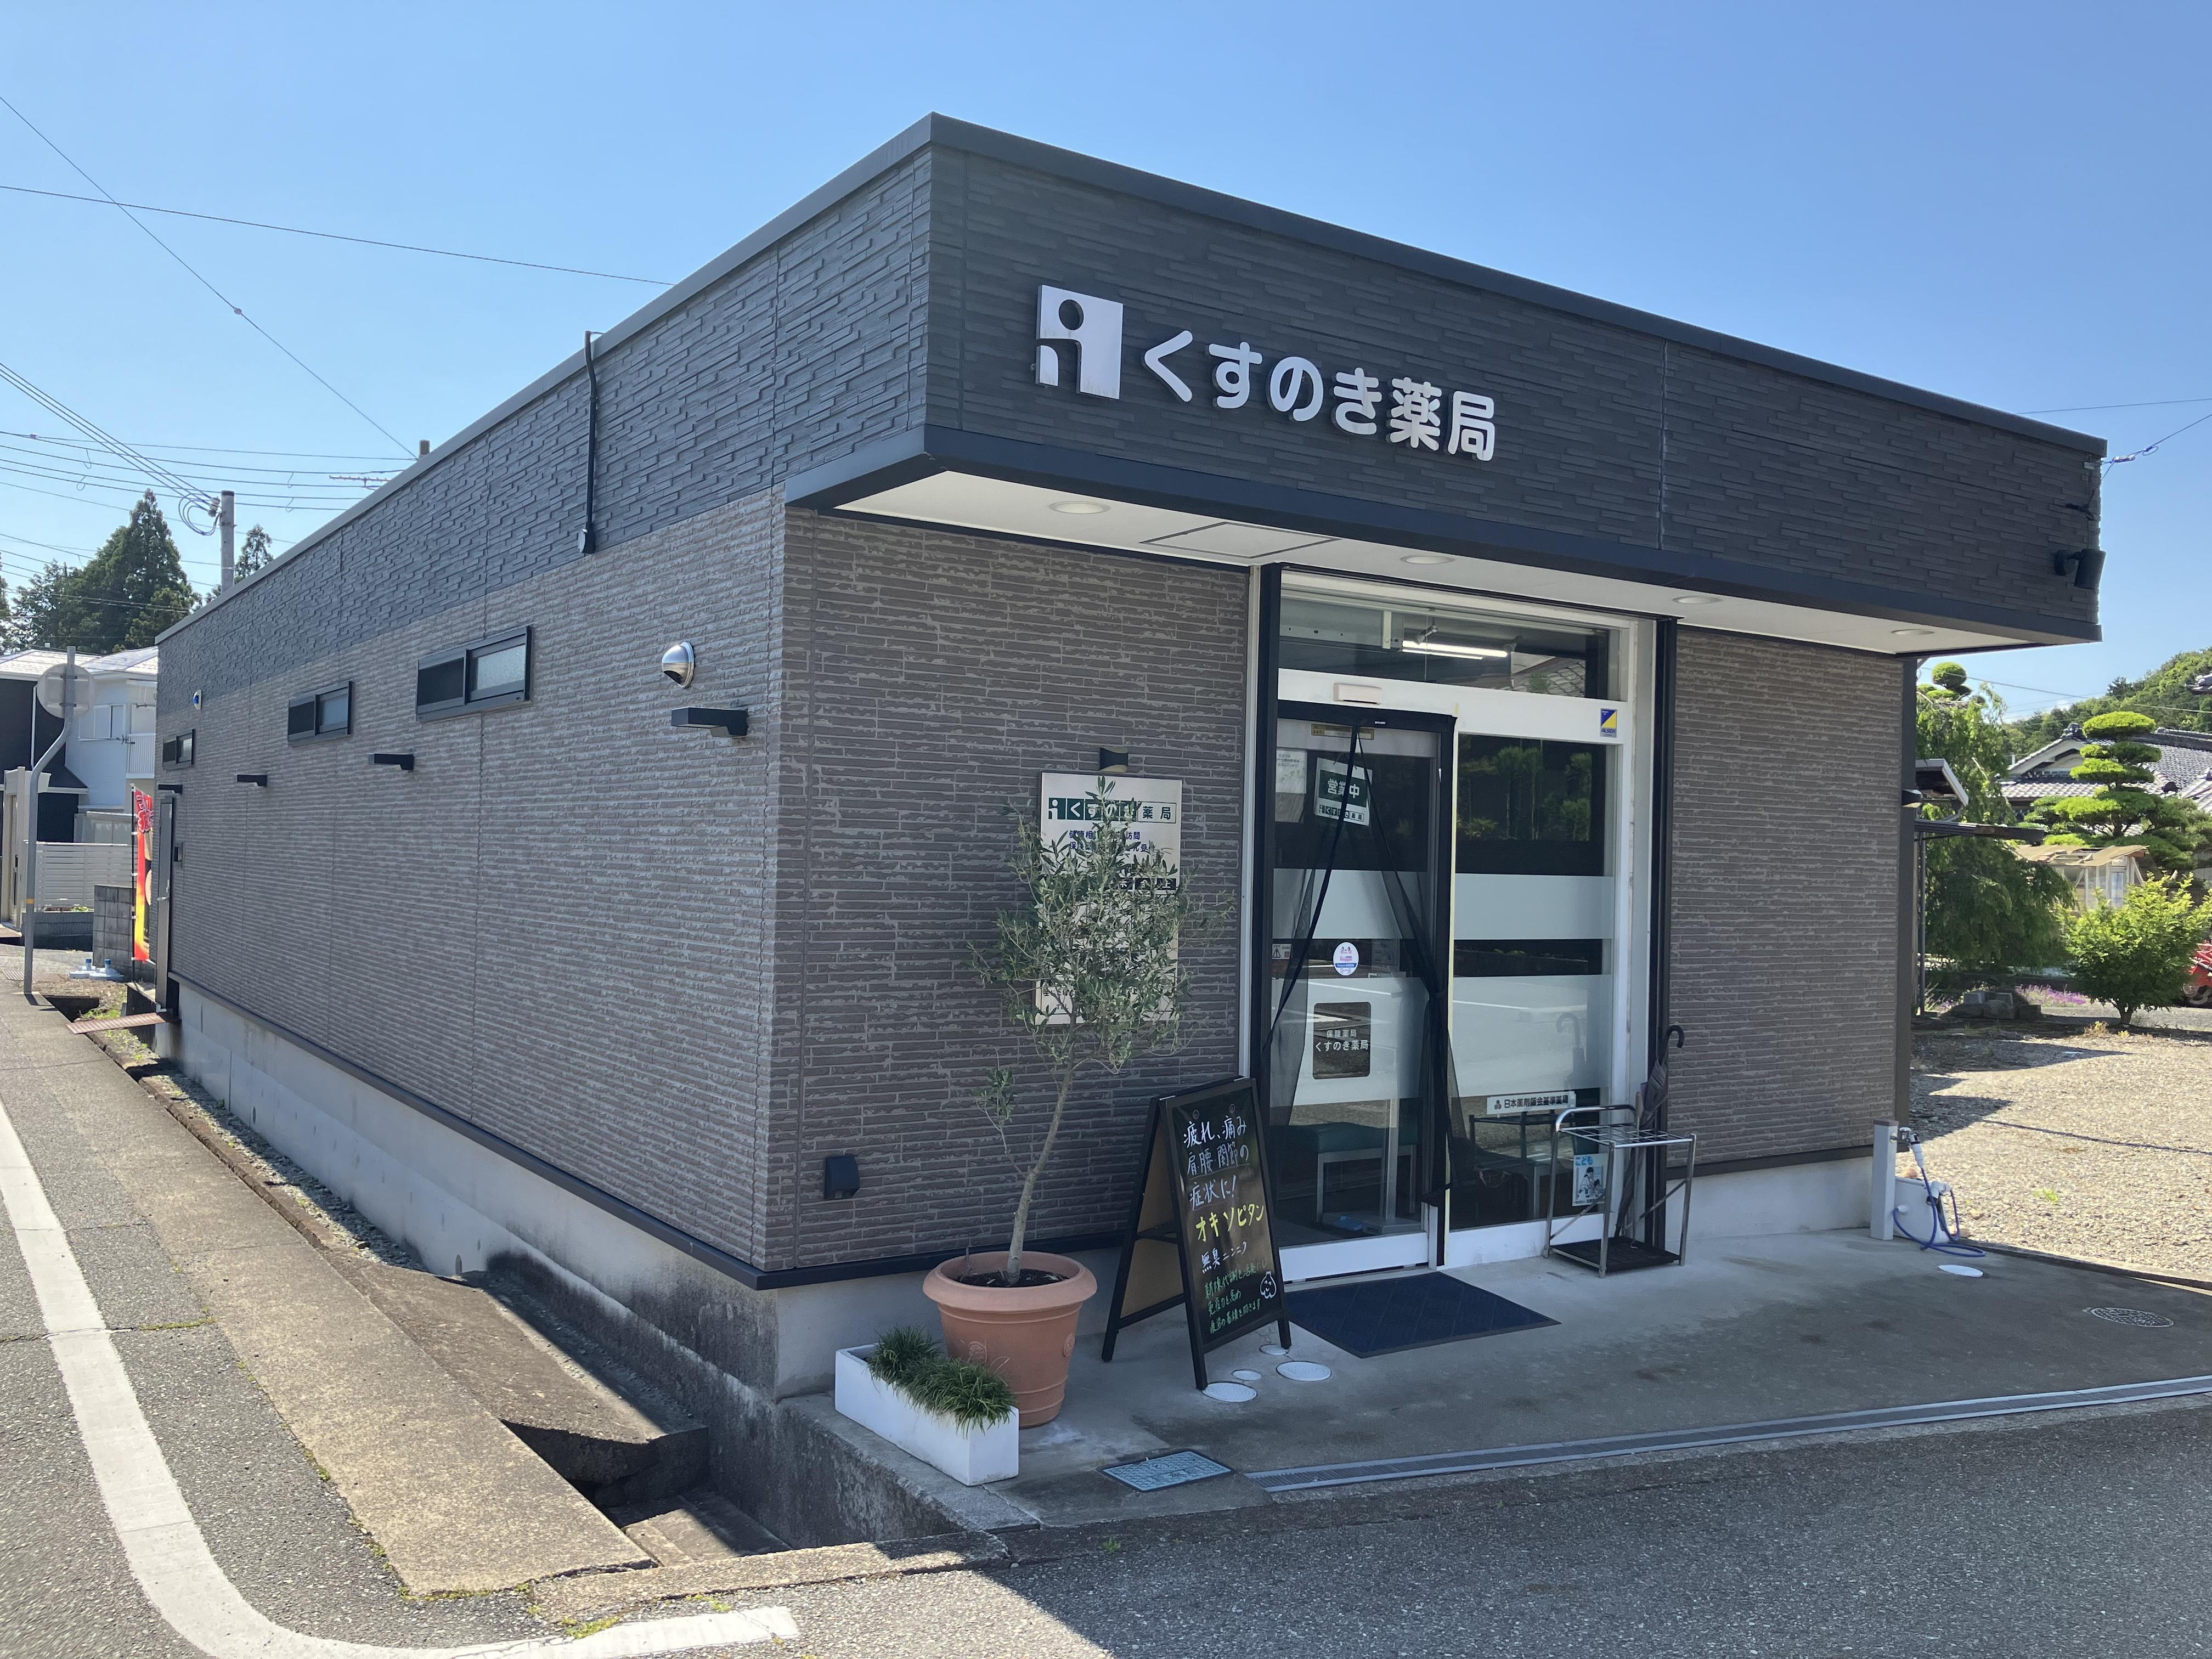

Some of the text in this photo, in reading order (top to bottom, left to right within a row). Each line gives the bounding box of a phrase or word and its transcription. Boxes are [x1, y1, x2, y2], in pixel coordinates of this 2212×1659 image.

[1143, 330, 1497, 462] くすのき薬局
[1328, 778, 1359, 799] 営業中
[1327, 1029, 1357, 1038] 保険薬局
[1315, 1040, 1368, 1052] くすのき薬局
[1504, 1094, 1568, 1108] 日本薬剤師会基準薬局
[1183, 1115, 1247, 1148] 疲れ、痛み
[1195, 1203, 1264, 1242] オキソピタン
